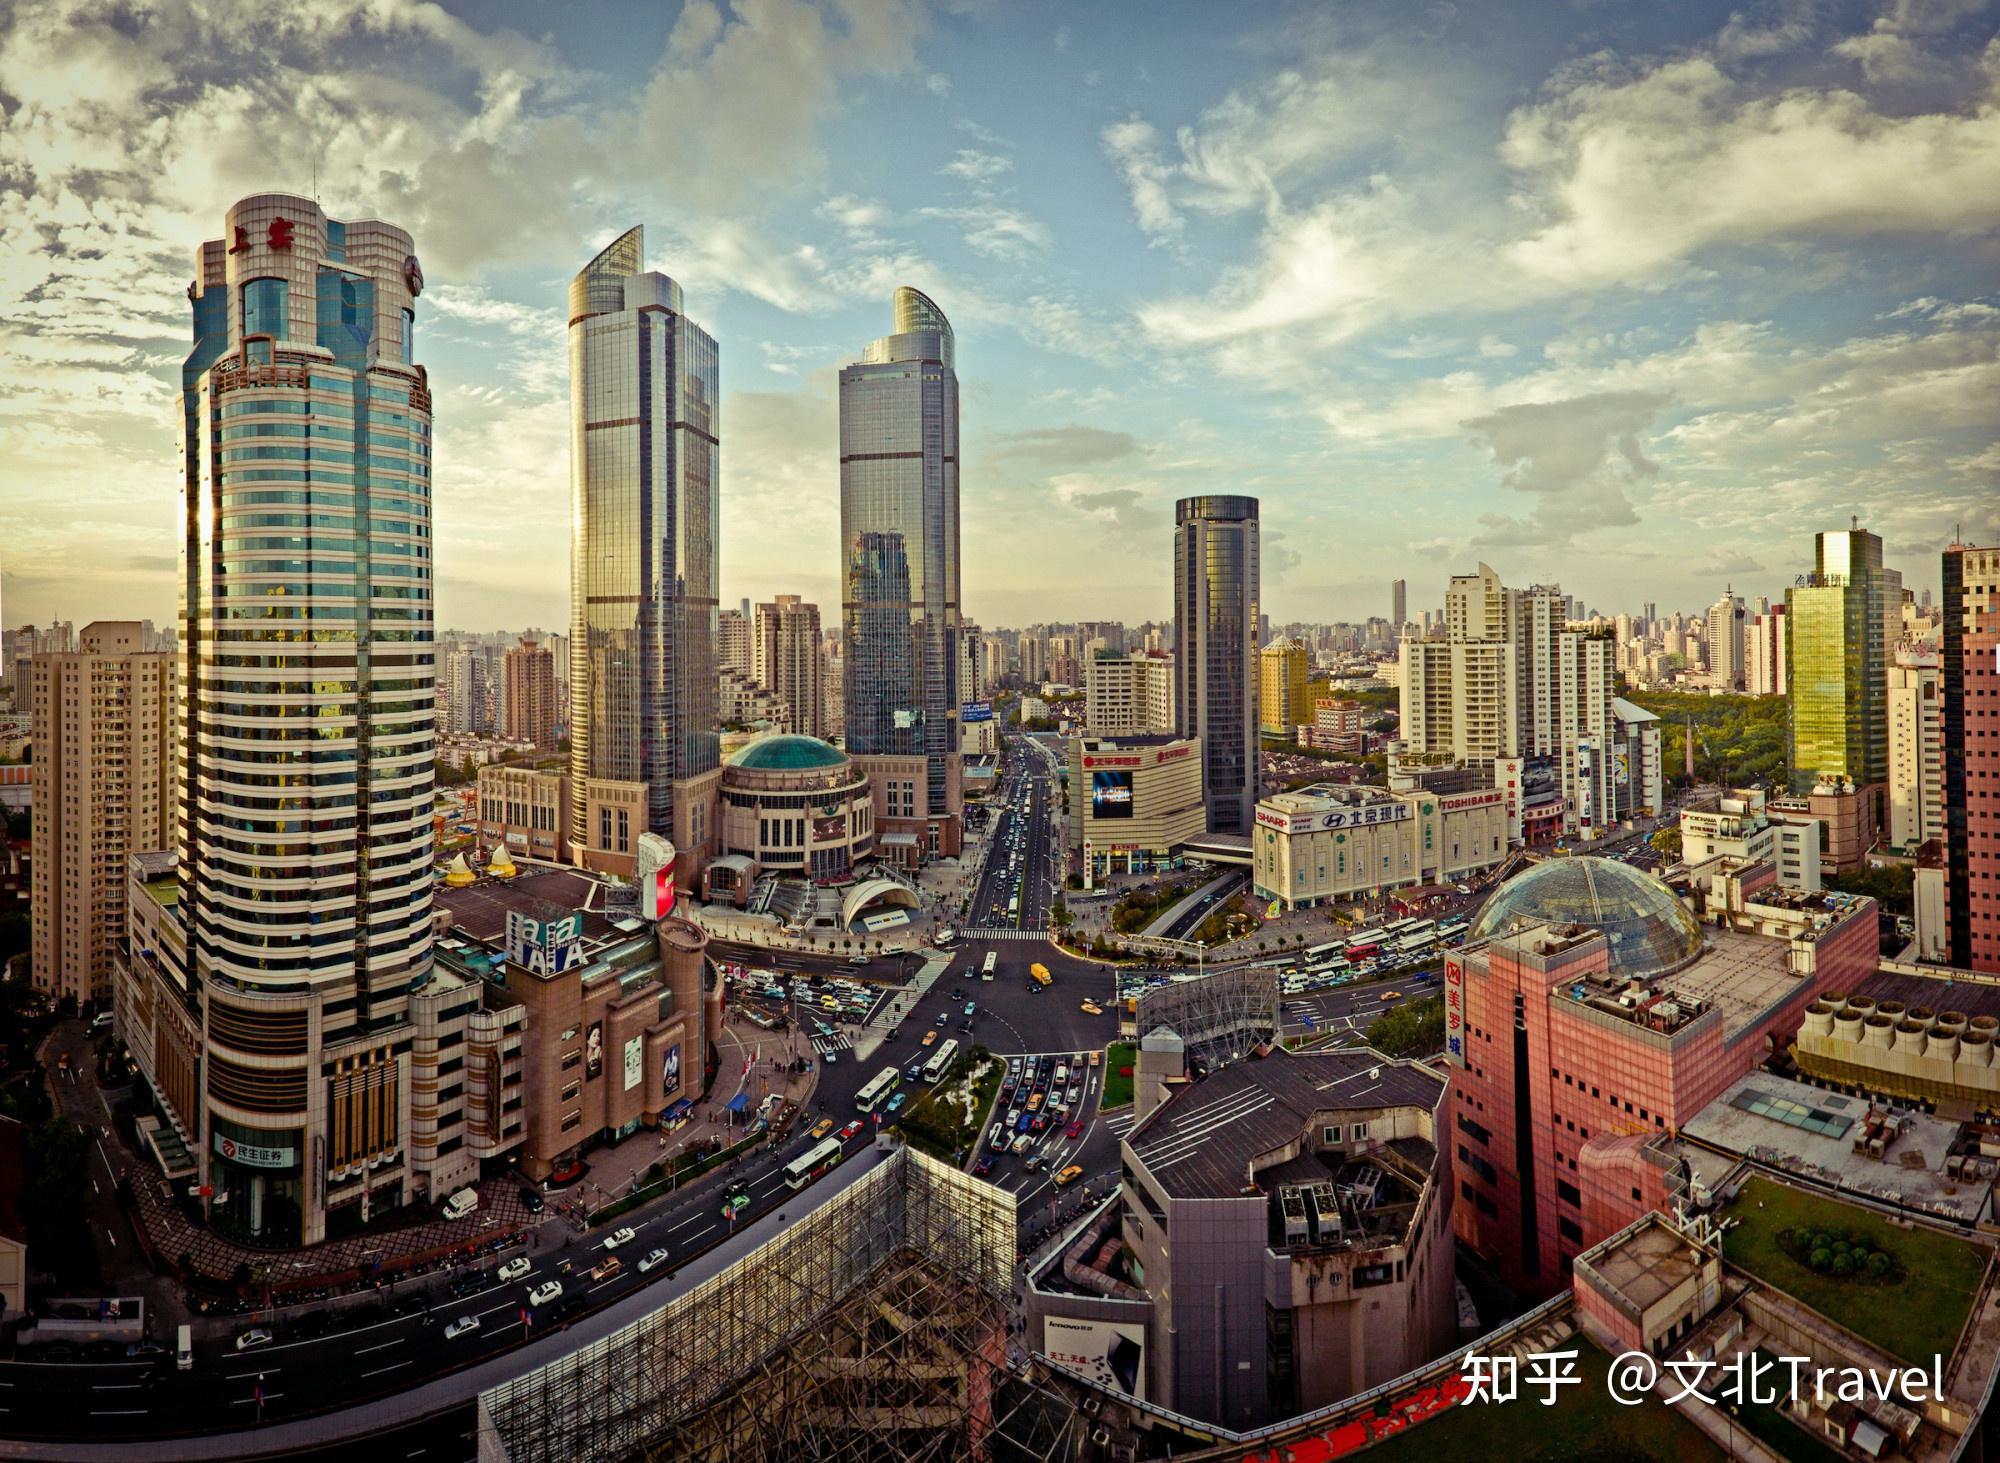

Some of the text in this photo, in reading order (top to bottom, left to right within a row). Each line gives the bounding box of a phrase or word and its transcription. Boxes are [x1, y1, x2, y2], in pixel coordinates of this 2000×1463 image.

[1441, 795, 1485, 810] TOSHIBA
[1256, 811, 1288, 828] SHARP
[1350, 804, 1407, 825] 北京现代
[1447, 989, 1461, 1056] 美罗城
[238, 1145, 282, 1161] 民生证券
[1049, 1321, 1080, 1330] lenovo
